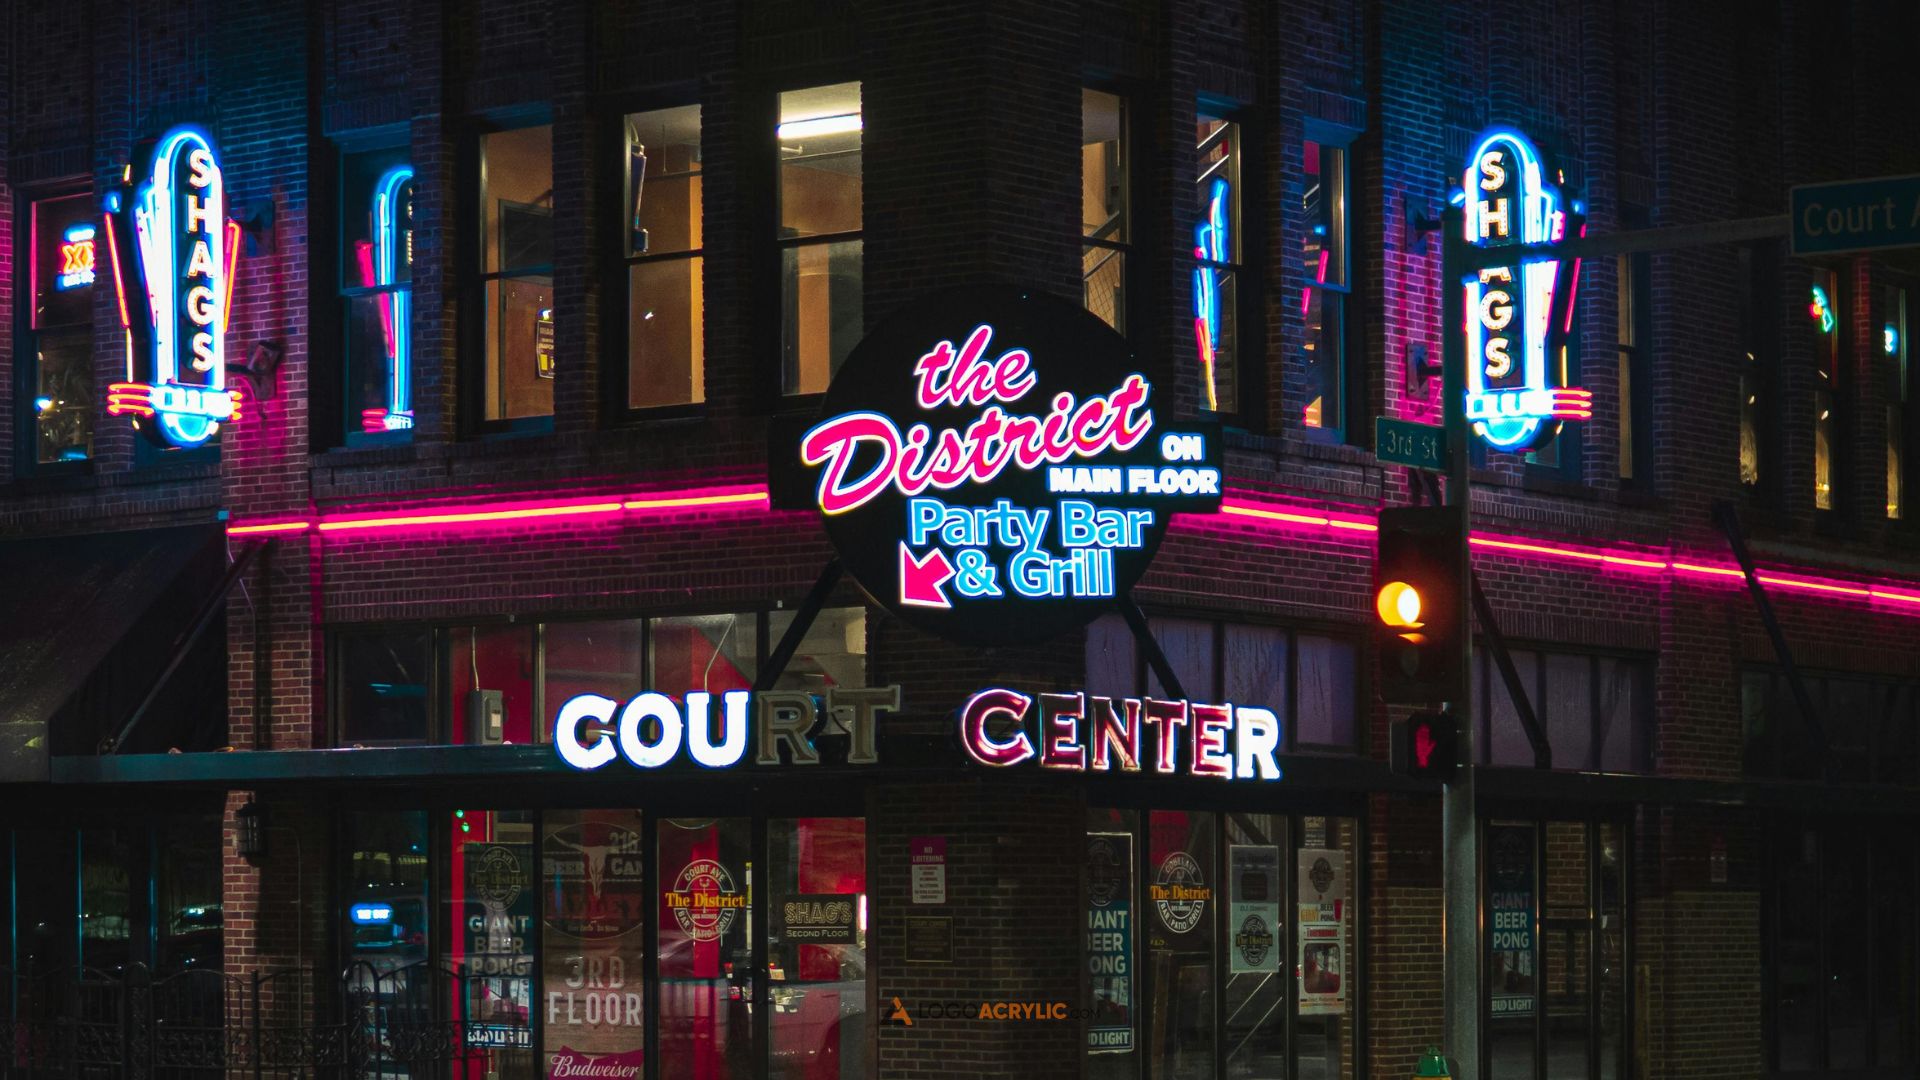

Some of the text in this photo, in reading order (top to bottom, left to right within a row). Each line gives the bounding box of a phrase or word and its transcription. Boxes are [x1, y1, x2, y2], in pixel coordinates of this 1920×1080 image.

[1803, 196, 1896, 237] Court
[187, 149, 216, 373] SHAGS
[914, 323, 1037, 409] the
[801, 373, 1153, 515] District
[1160, 434, 1204, 461] ON
[1387, 429, 1438, 461] 3rd St
[1047, 466, 1219, 495] MAIN FLOOR
[909, 498, 1152, 554] Party Bar
[954, 548, 1116, 597] & Grill
[553, 684, 1281, 781] COURT CENTER
[684, 864, 726, 882] COURT AVE
[665, 892, 745, 908] The District
[1150, 884, 1211, 900] The District
[468, 914, 529, 933] GIANT
[1088, 910, 1128, 929] IANT
[1495, 911, 1528, 929] BEER
[474, 937, 525, 954] BEER
[1493, 931, 1530, 949] PONG
[471, 957, 528, 976] PONG
[564, 955, 626, 990] 3RD
[1088, 954, 1126, 975] ONG
[547, 991, 642, 1027] FLOOR
[1508, 999, 1533, 1011] LIGHT
[1098, 1031, 1130, 1046] LIGHT
[550, 1054, 641, 1080] Budweiser
